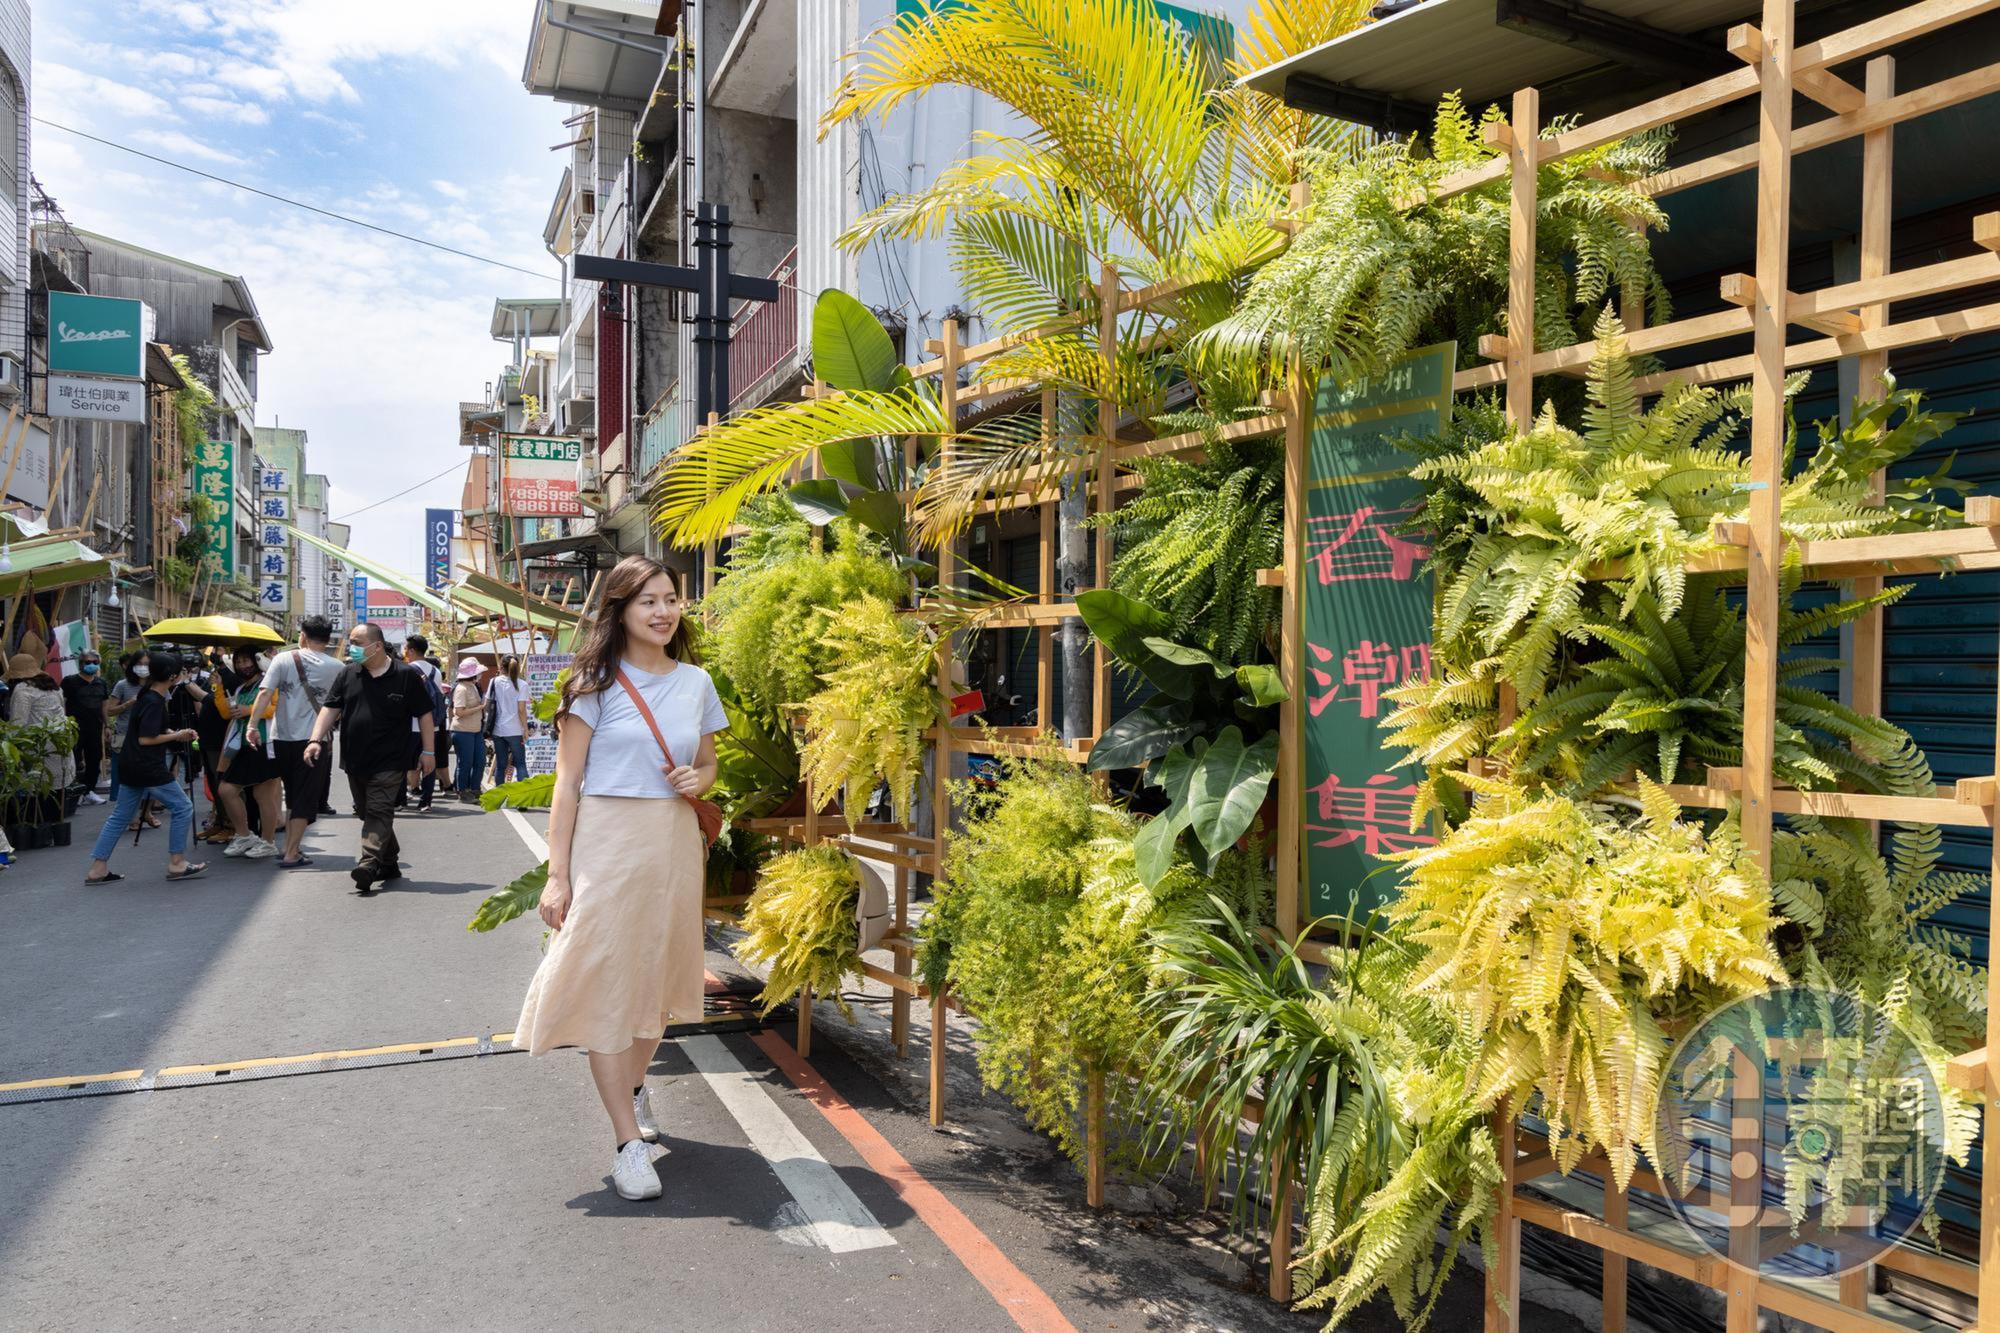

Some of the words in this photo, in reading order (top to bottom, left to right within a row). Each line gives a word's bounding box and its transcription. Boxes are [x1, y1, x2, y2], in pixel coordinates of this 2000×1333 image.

[58, 321, 131, 343] Vespa
[59, 386, 130, 402] 瑋仕伯興業
[71, 399, 121, 413] Service
